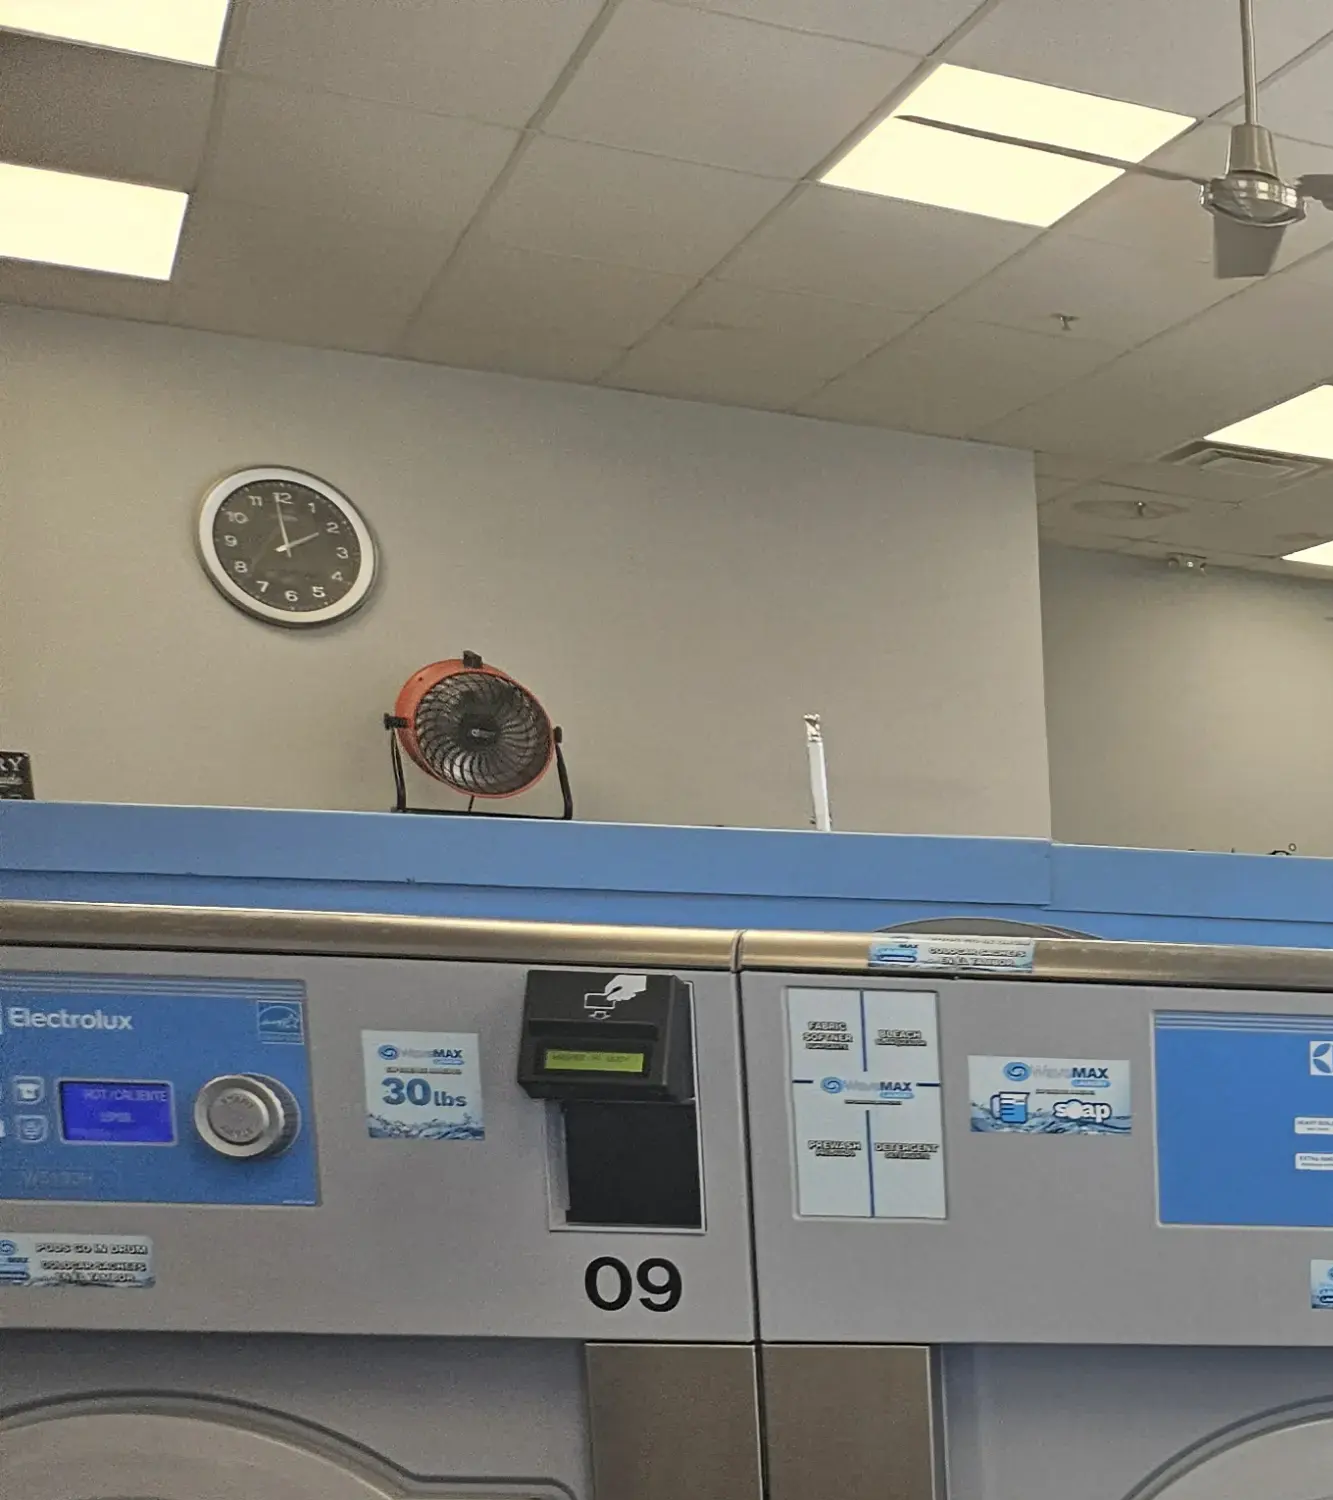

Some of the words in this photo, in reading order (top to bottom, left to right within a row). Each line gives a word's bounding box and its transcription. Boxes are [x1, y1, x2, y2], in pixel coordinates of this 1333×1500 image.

[248, 494, 262, 507] 11
[308, 502, 316, 513] 1
[226, 511, 248, 524] 10
[326, 522, 340, 534] 2
[224, 535, 237, 547] 9
[336, 547, 349, 559] 3
[234, 561, 248, 573] 8
[331, 571, 343, 582] 4
[257, 580, 270, 592] 7
[312, 586, 325, 598] 5
[285, 590, 298, 602] 6
[7, 1006, 133, 1031] Electrolux
[808, 1021, 847, 1032] FABRIC
[1053, 1099, 1113, 1123] soap
[808, 1140, 861, 1150] PREWASH
[874, 1143, 939, 1153] DETERGENT
[584, 1256, 682, 1312] 09
